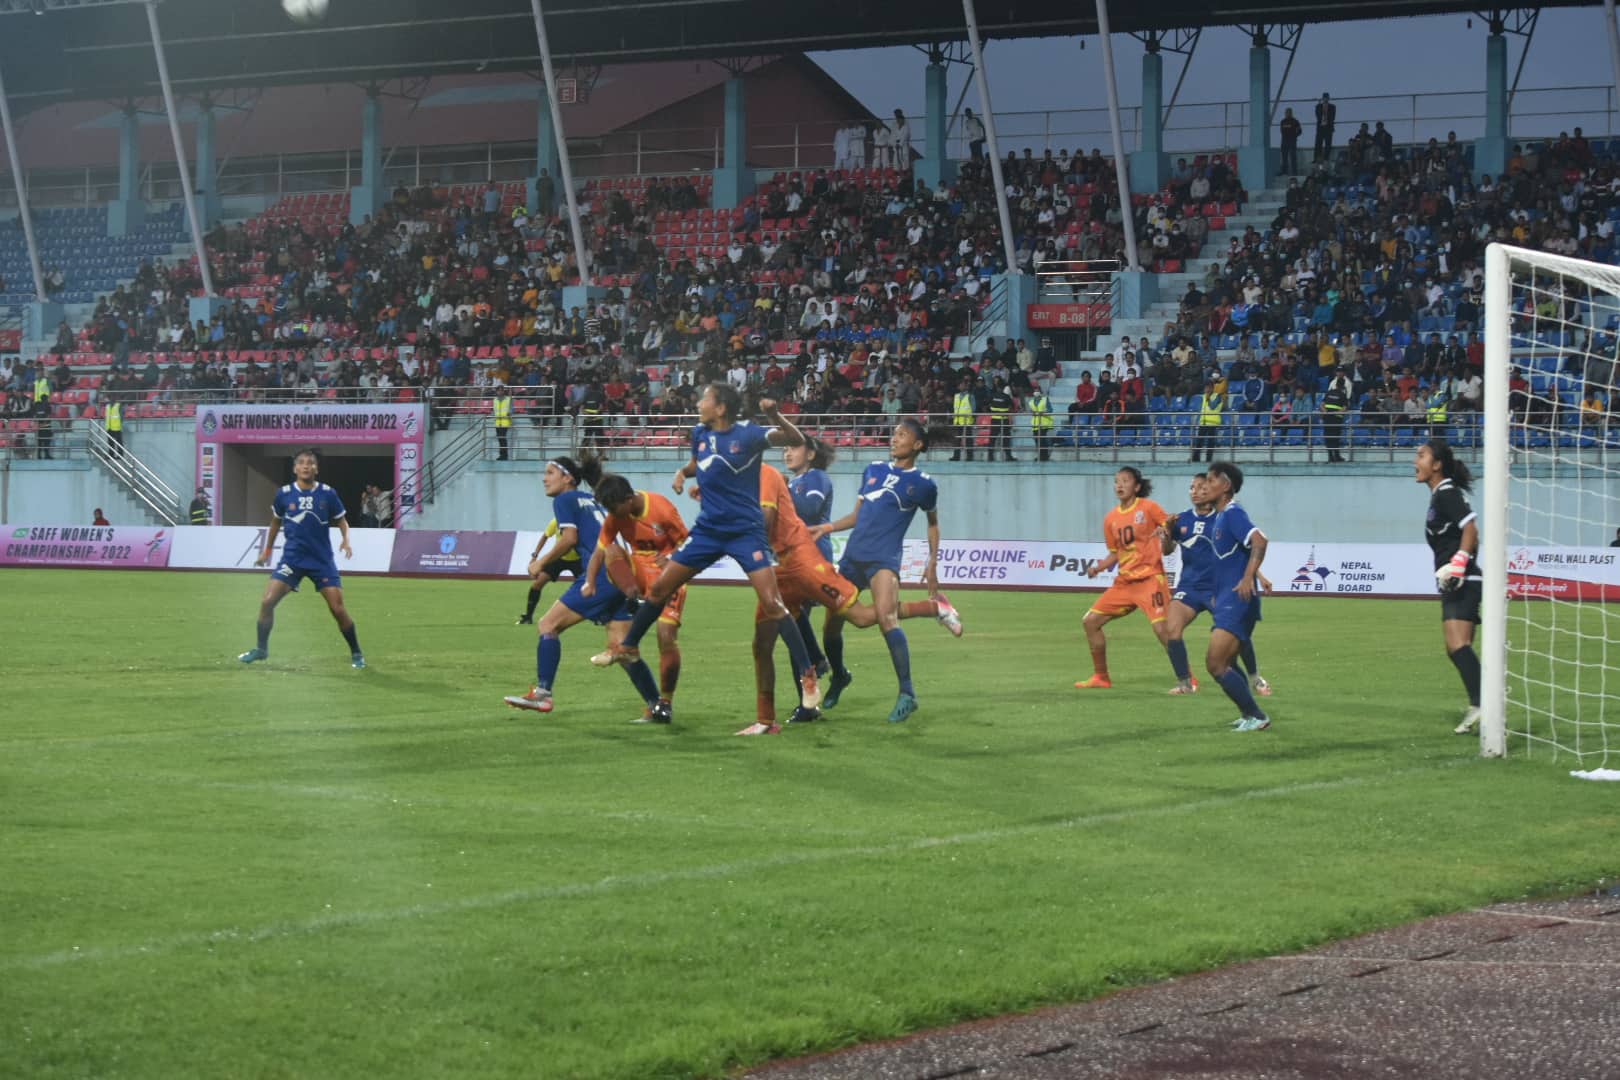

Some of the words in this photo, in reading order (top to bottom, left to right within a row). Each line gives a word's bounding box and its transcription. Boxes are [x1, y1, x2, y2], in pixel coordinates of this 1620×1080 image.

[221, 413, 244, 430] SAFF
[246, 413, 291, 430] WOMEN'S
[293, 413, 369, 430] CHAMPIONSHIP
[371, 413, 398, 430] 2022
[882, 473, 900, 489] 12
[298, 496, 313, 510] 23
[30, 527, 58, 541] SAFF
[60, 527, 115, 542] WOMEN'S
[1118, 524, 1135, 547] 10
[1193, 521, 1206, 535] 15
[100, 545, 132, 560] 2022
[936, 548, 966, 562] BUY
[969, 549, 1027, 563] ONLINE
[1537, 553, 1565, 564] NEPAL
[1566, 554, 1587, 565] WALL
[1027, 559, 1045, 569] VIA
[1340, 561, 1373, 570] NEPAL
[943, 565, 1008, 580] TICKETS
[1340, 572, 1385, 581] TOURISM
[1337, 583, 1373, 592] BOARD
[1151, 591, 1164, 609] 10
